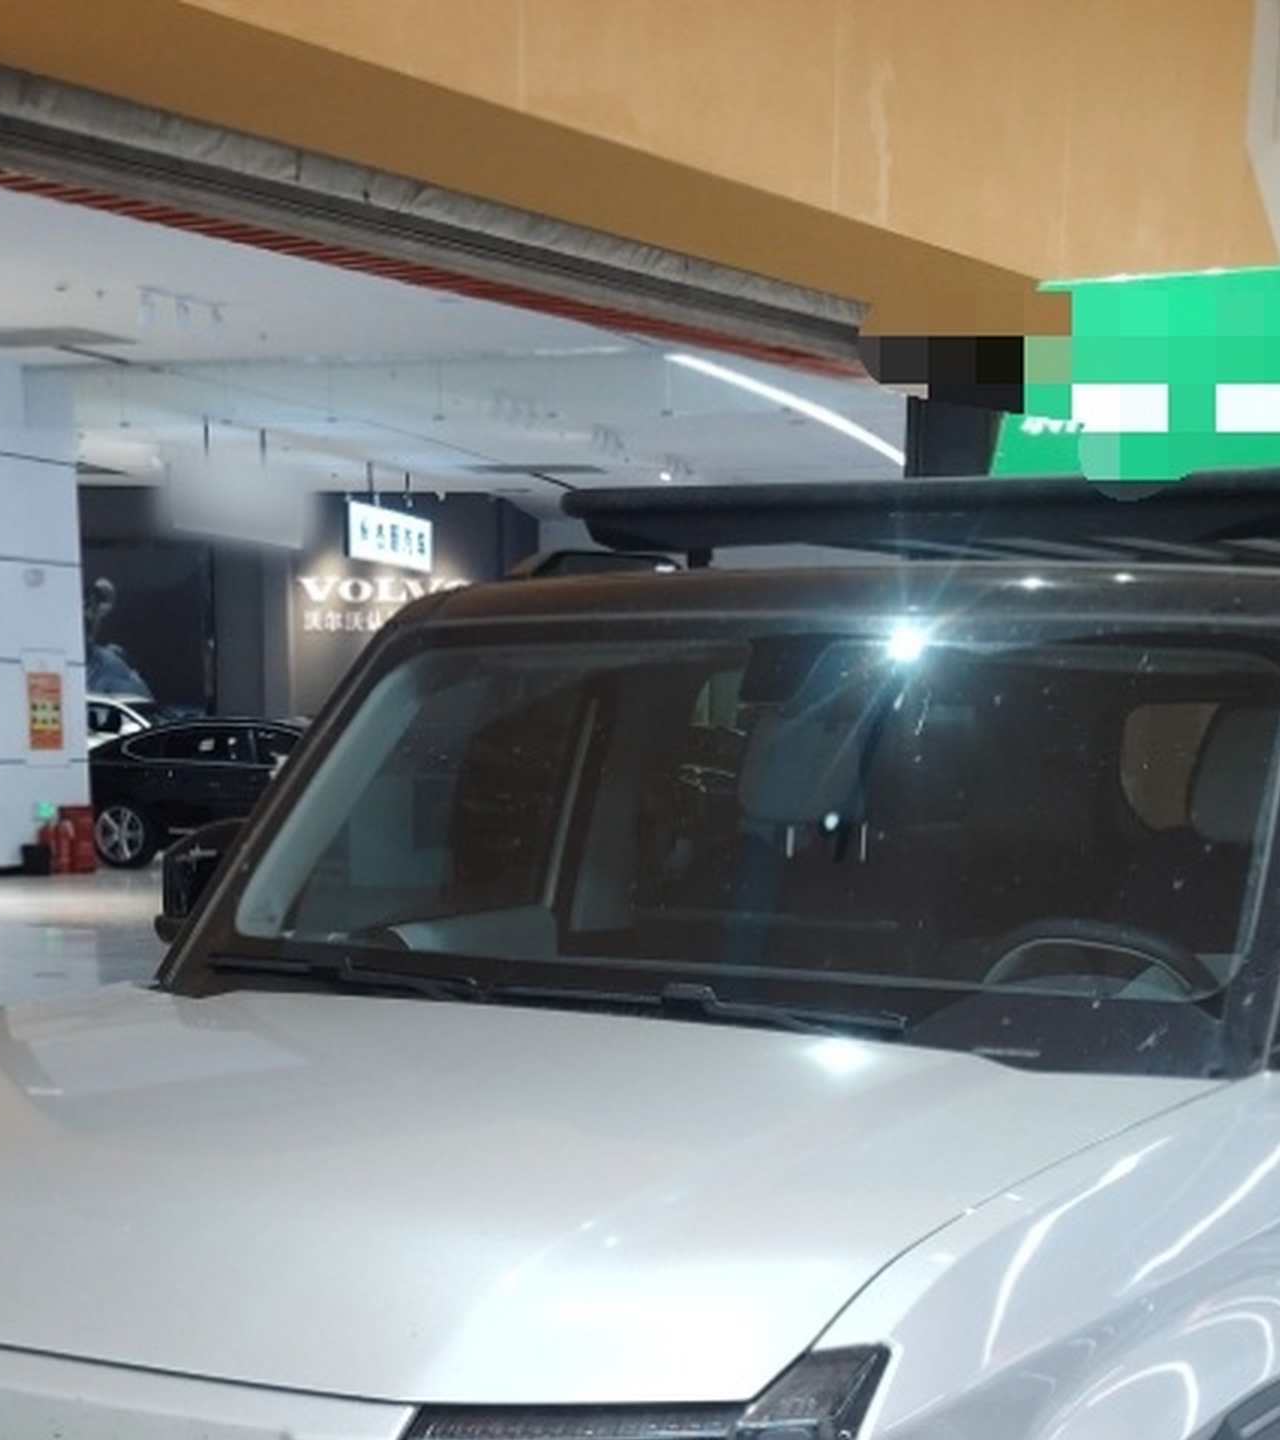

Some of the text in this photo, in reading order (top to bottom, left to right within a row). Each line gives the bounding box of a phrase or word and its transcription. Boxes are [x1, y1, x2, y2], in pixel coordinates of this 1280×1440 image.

[298, 577, 472, 603] VOLV
[303, 610, 392, 631] 沃尔沃认
